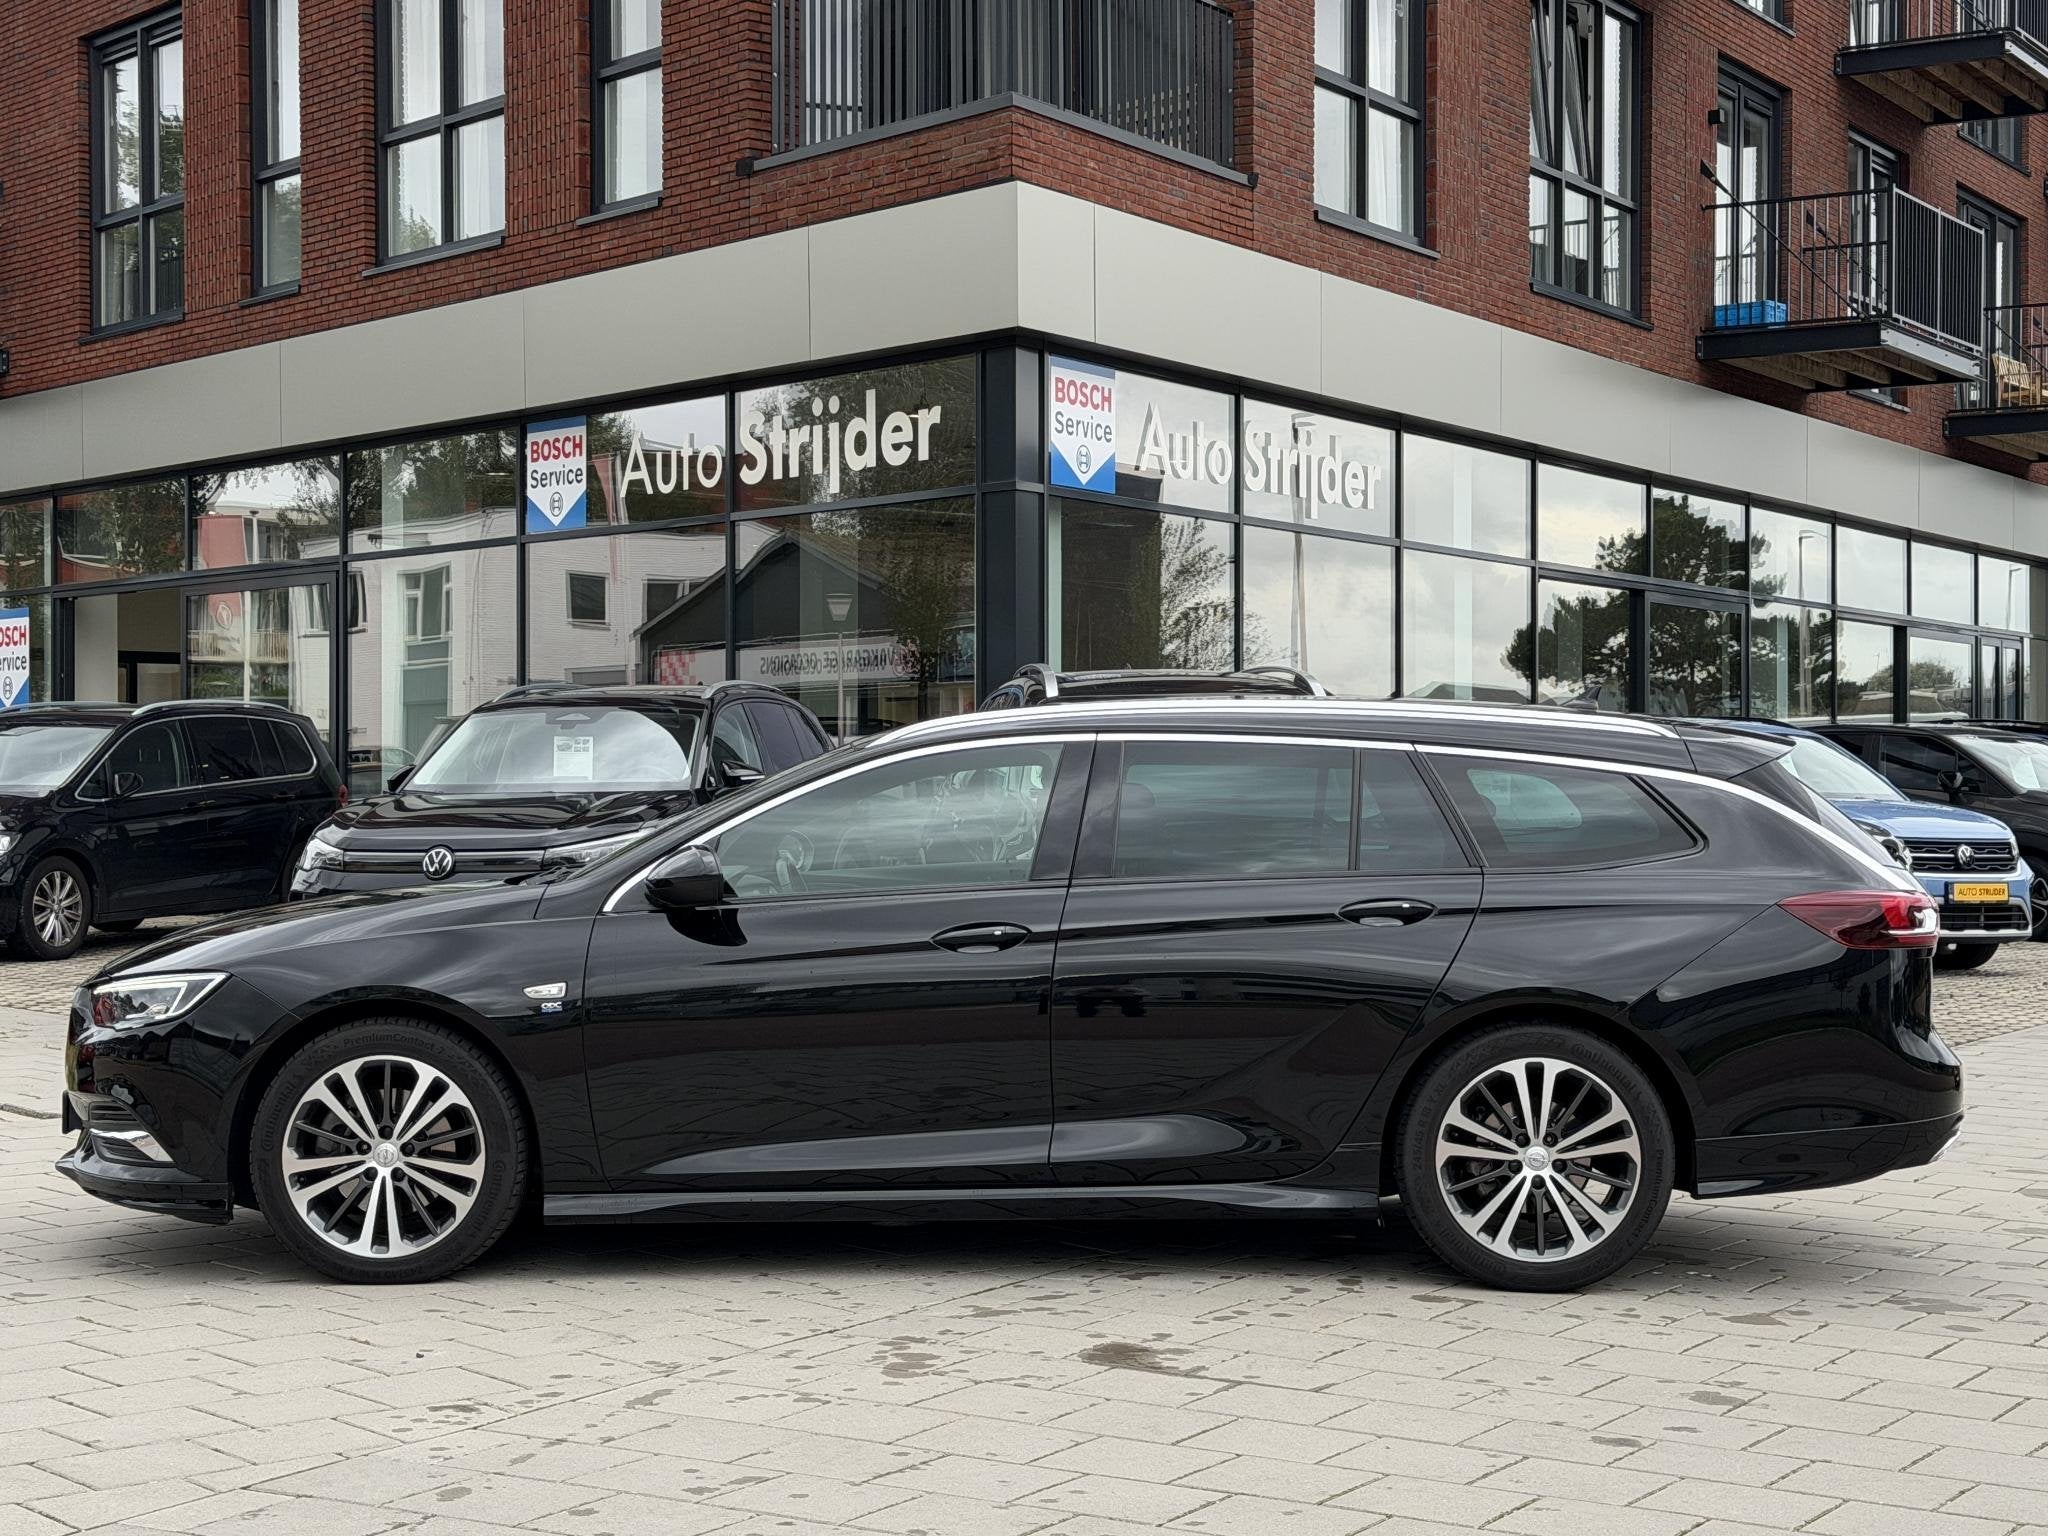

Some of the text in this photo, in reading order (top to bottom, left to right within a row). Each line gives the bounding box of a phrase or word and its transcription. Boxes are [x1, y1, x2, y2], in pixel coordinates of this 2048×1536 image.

[1054, 376, 1112, 413] BOSCH
[1054, 411, 1112, 443] Service
[530, 434, 583, 464] BOSCH
[620, 389, 942, 498] Auto Strijder
[530, 464, 584, 489] Service
[1136, 402, 1382, 519] Auto Strijder
[1958, 887, 1978, 896] AUTO
